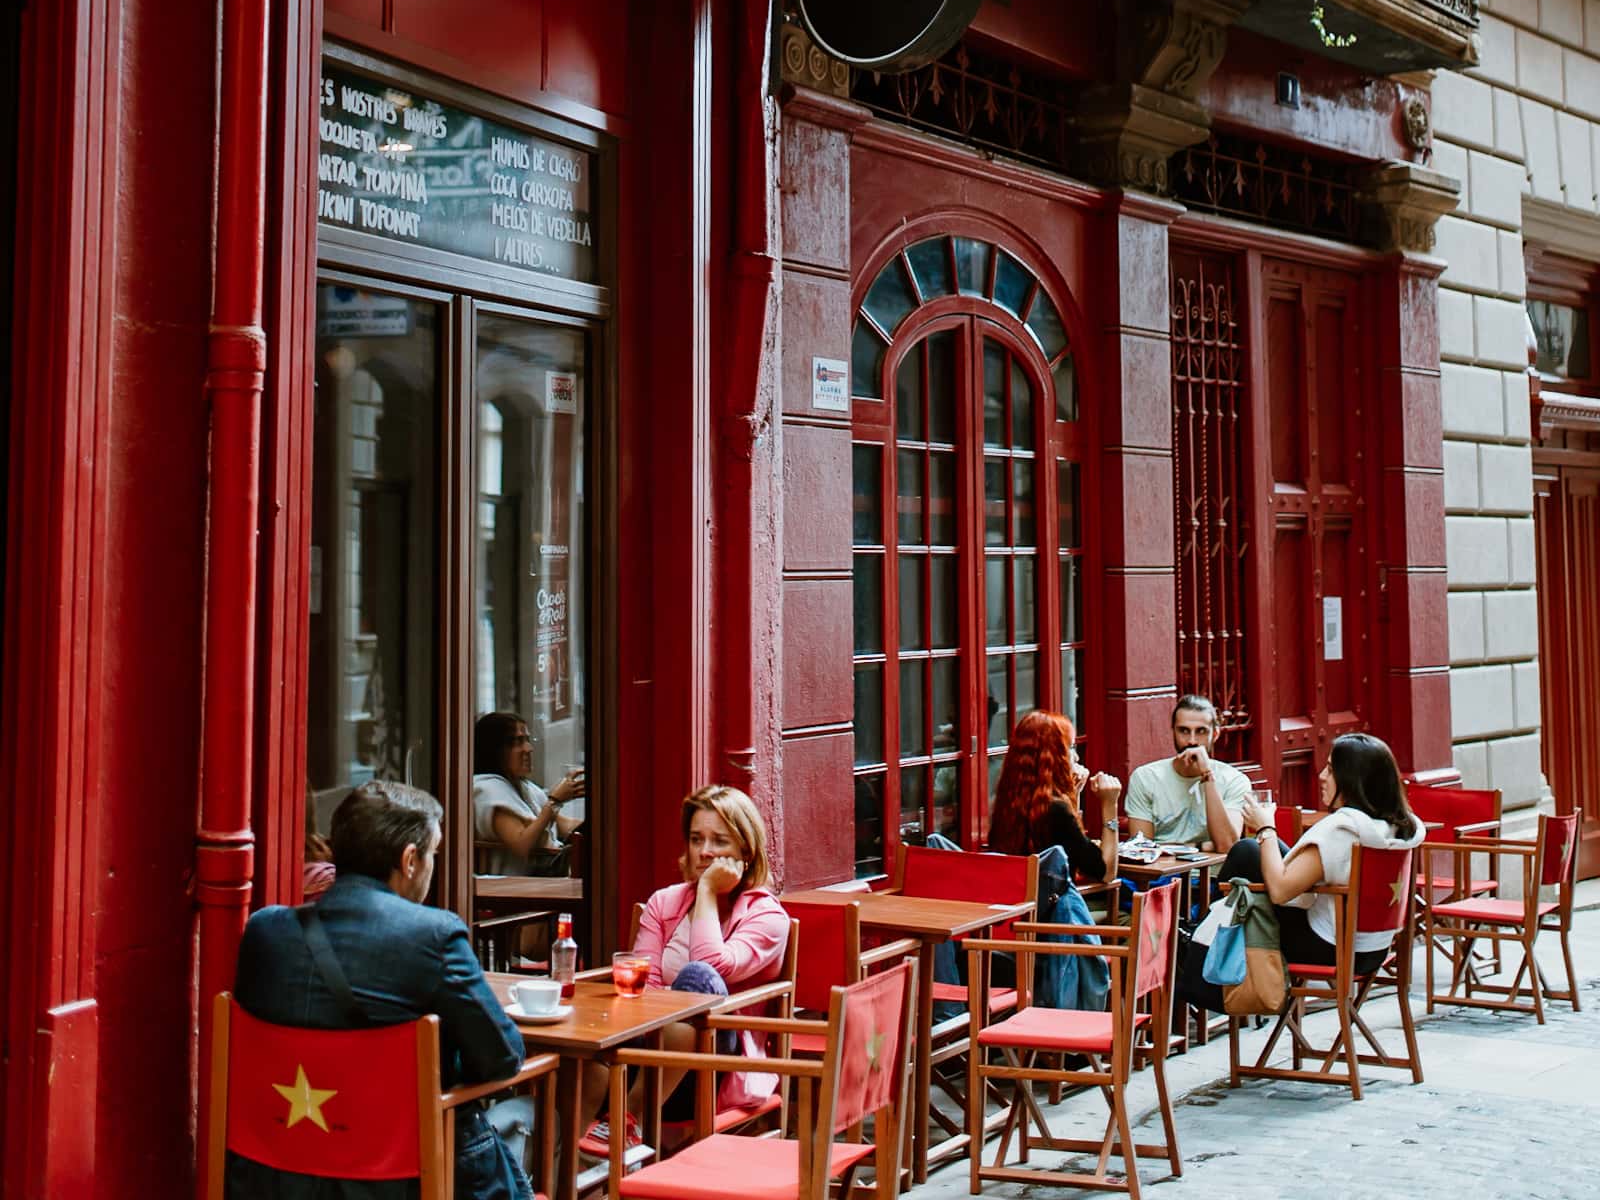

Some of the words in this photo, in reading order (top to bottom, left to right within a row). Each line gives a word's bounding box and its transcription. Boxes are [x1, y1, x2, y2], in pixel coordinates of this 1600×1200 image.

[491, 136, 530, 170] HUMUS
[532, 148, 545, 173] DE
[363, 166, 428, 205] TONYINA
[490, 172, 518, 199] COCA
[521, 181, 574, 212] CARXOFA
[360, 198, 421, 238] TOFONAT
[531, 209, 545, 236] DE
[546, 215, 592, 247] VEDELLA
